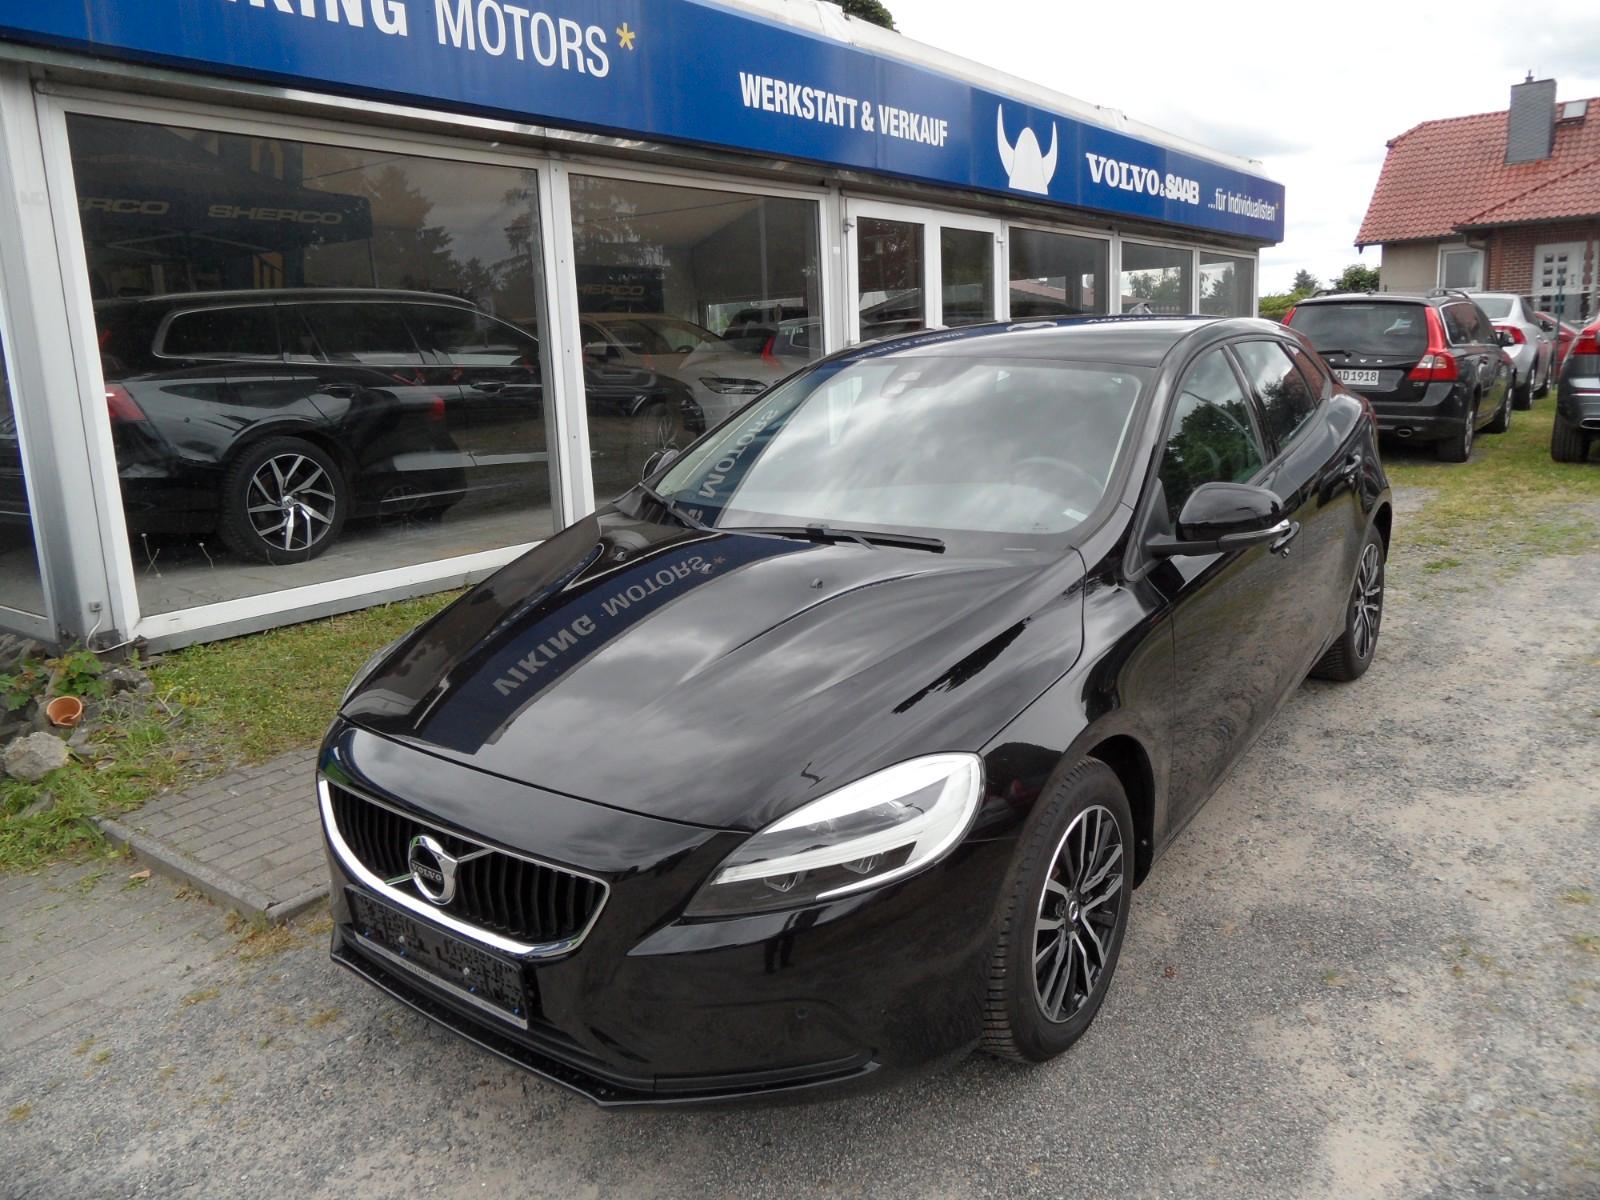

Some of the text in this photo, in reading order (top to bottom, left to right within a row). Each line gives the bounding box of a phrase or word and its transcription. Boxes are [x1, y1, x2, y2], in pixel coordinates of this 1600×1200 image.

[434, 0, 610, 78] MOTORS
[739, 72, 948, 147] WERKSTATT & VERKAUF
[1085, 152, 1160, 196] VOLVO
[1165, 173, 1200, 205] SAAB
[207, 204, 343, 225] SHERCO
